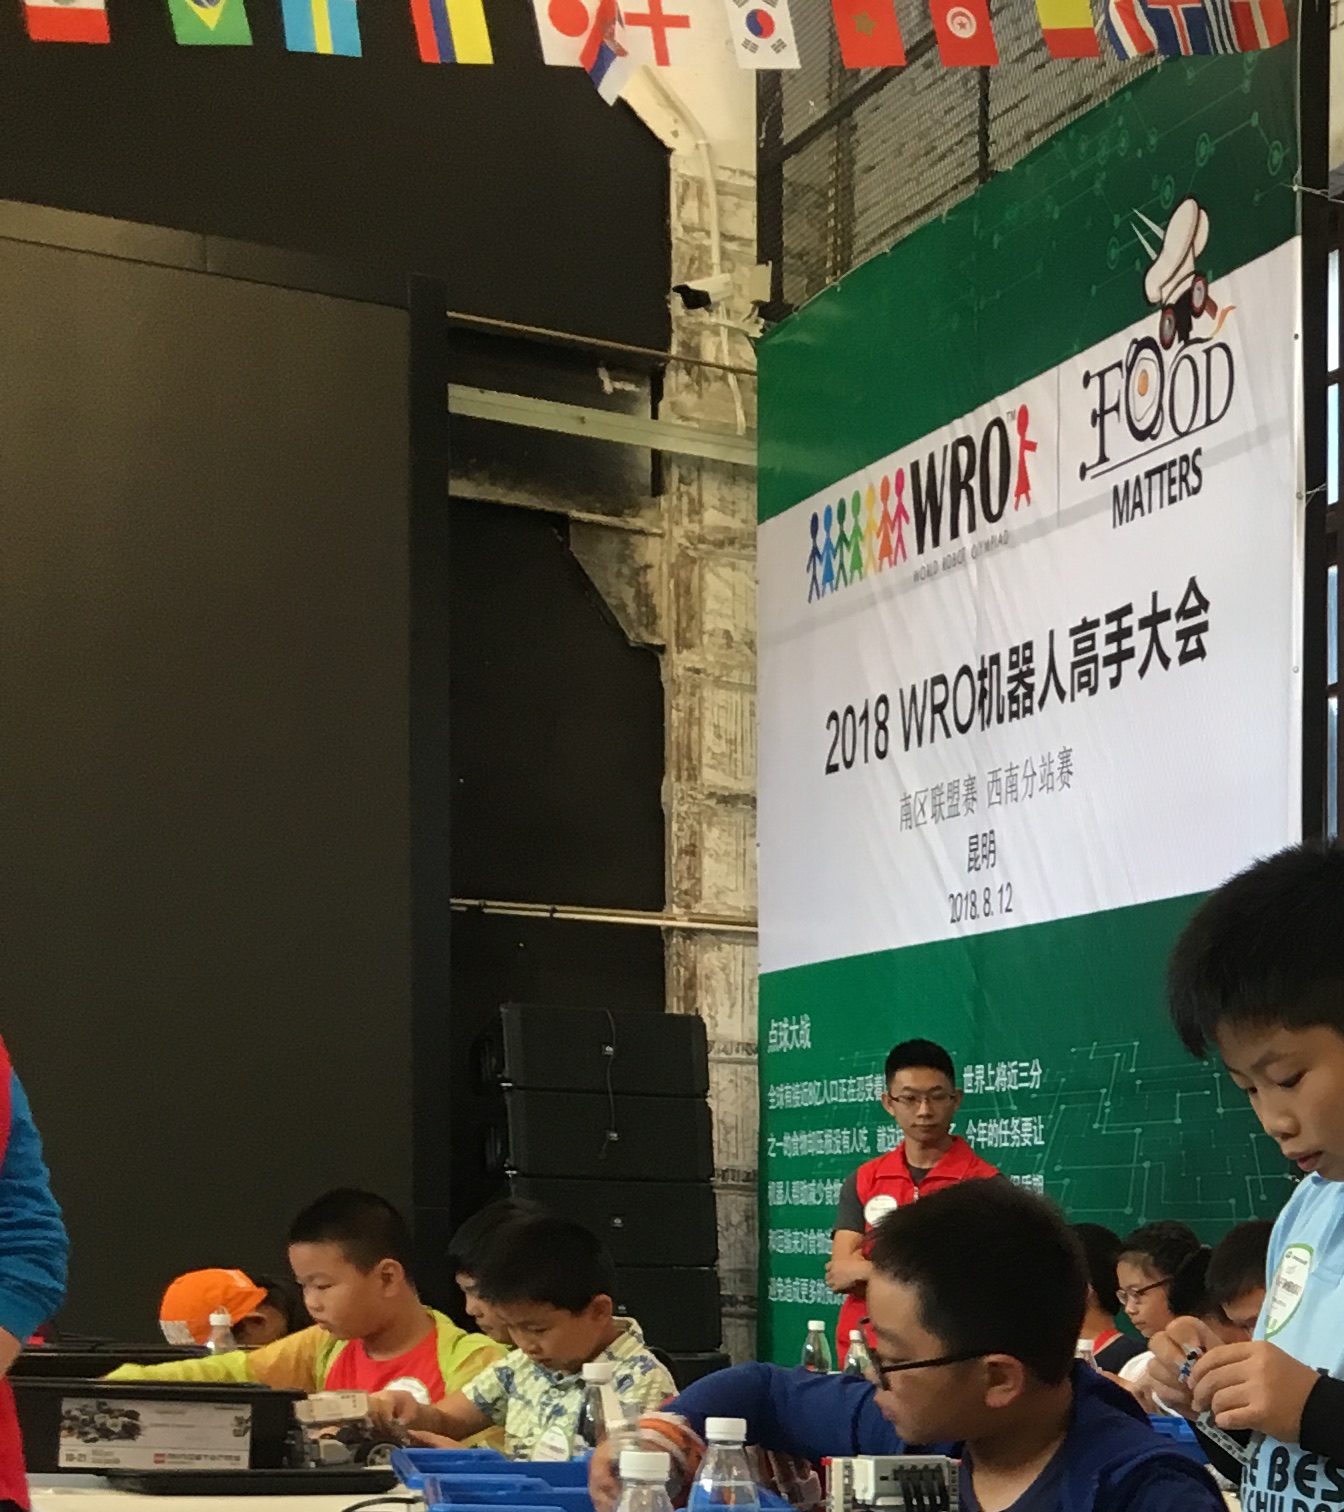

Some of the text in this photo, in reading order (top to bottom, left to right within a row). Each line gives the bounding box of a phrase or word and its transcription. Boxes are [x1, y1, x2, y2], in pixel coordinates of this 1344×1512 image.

[911, 418, 1011, 554] WRO
[1110, 447, 1204, 529] MATTERS
[824, 576, 1211, 774] 2018 WRO机器人高手大会
[898, 746, 1074, 832] 南区联盟赛 西南分站赛
[966, 829, 997, 874] 昆明
